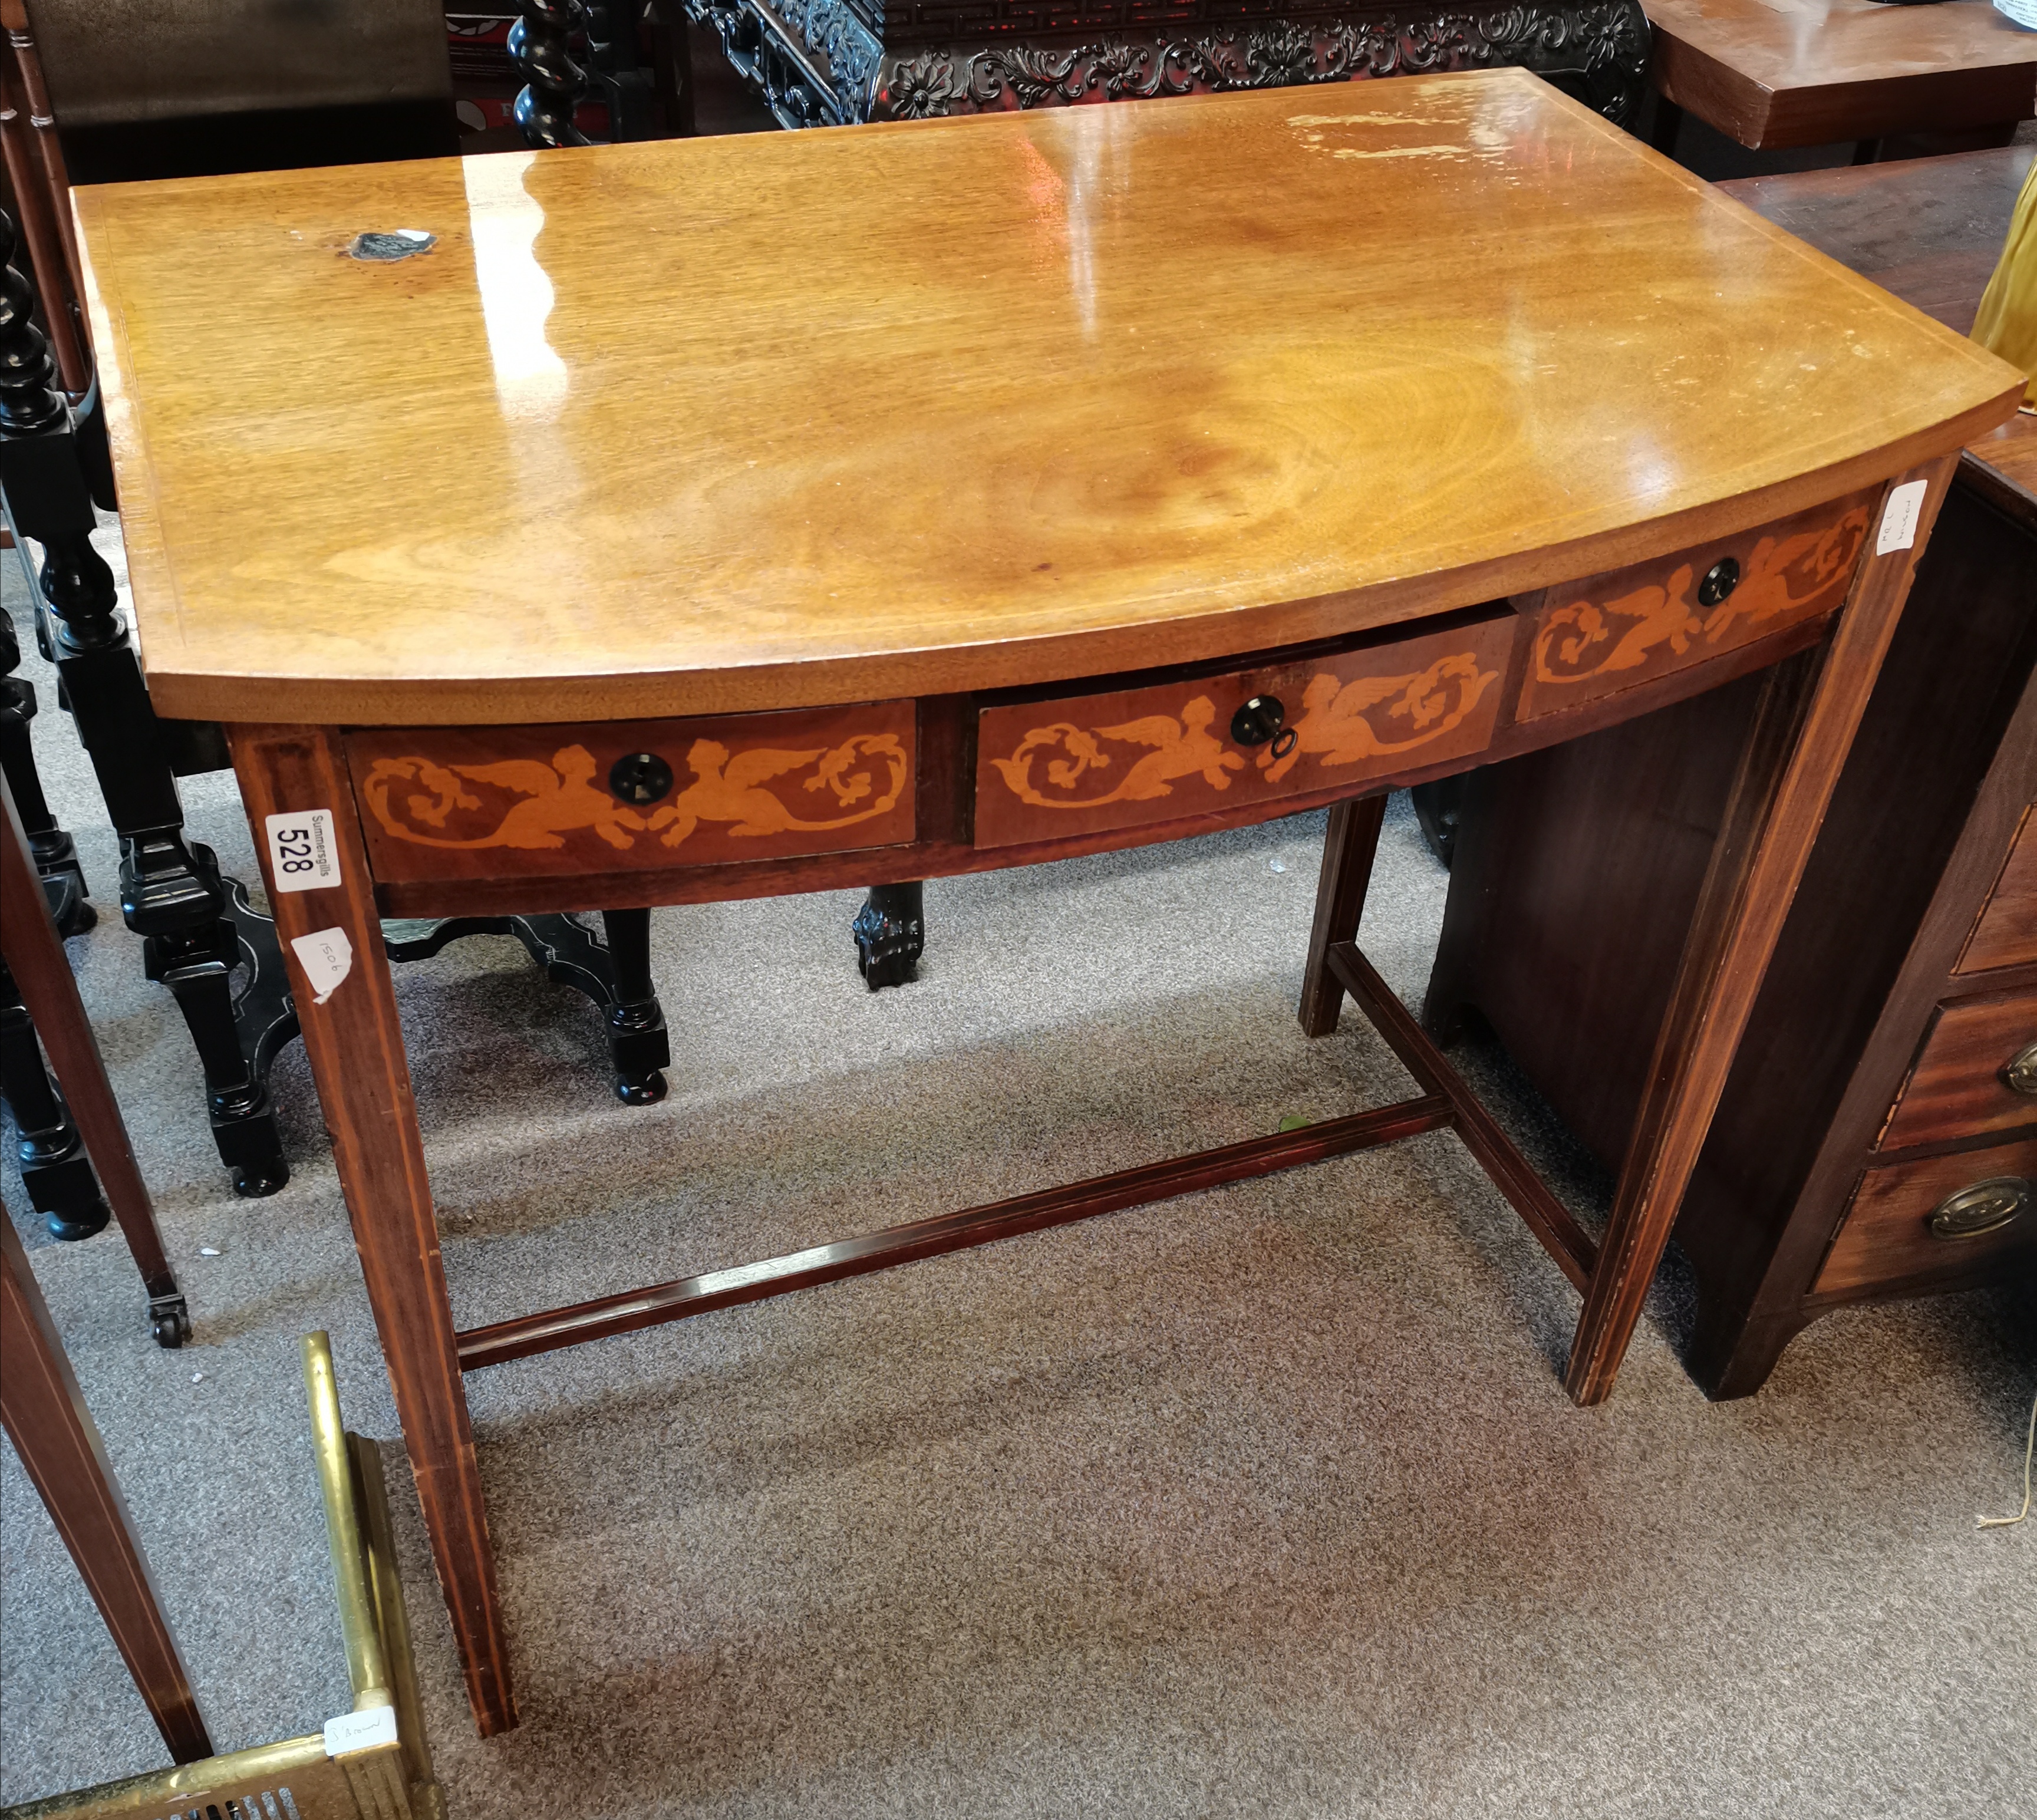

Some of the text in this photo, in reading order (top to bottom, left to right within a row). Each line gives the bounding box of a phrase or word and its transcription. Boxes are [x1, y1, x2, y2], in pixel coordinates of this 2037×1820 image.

[277, 829, 314, 873] 528
[312, 815, 331, 877] Summersgills
[319, 942, 343, 972] 1506
